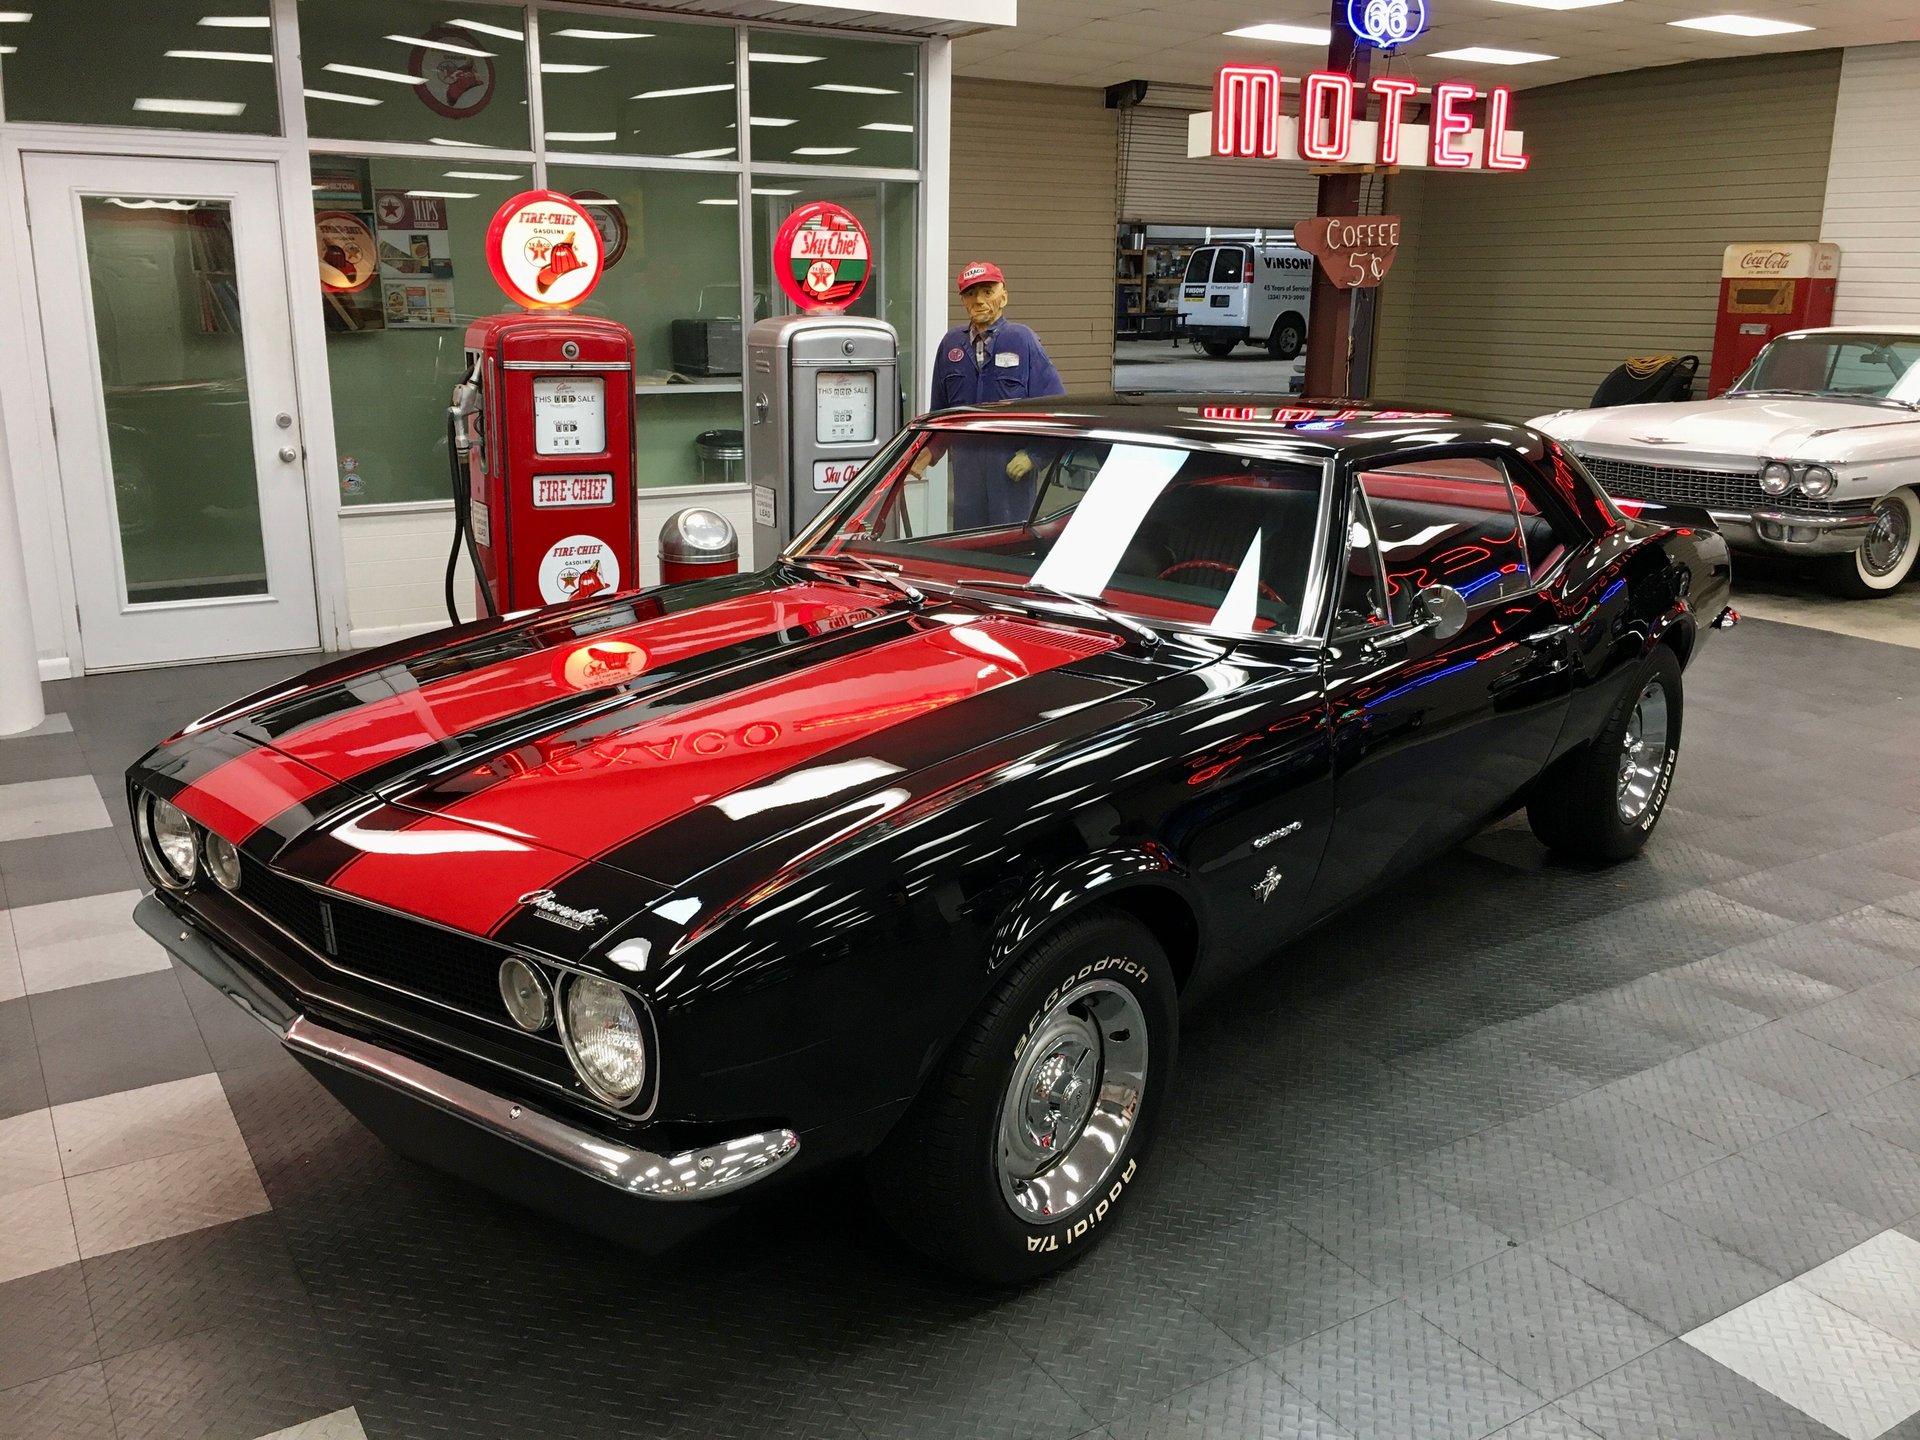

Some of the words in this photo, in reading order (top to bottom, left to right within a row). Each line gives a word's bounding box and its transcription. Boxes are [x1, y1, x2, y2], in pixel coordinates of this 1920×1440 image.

[1364, 0, 1408, 37] 66
[1210, 63, 1531, 170] MOTEL
[519, 212, 578, 226] FIRE-CHIEF
[801, 231, 827, 257] Sky
[827, 231, 859, 256] Chief
[1326, 217, 1399, 250] COFFEE
[964, 268, 985, 278] TEXACO
[577, 395, 596, 403] SALE
[823, 467, 841, 484] Sky
[1653, 749, 1675, 811] Radial
[1067, 1158, 1137, 1245] Radial
[1027, 1235, 1059, 1252] T/A
